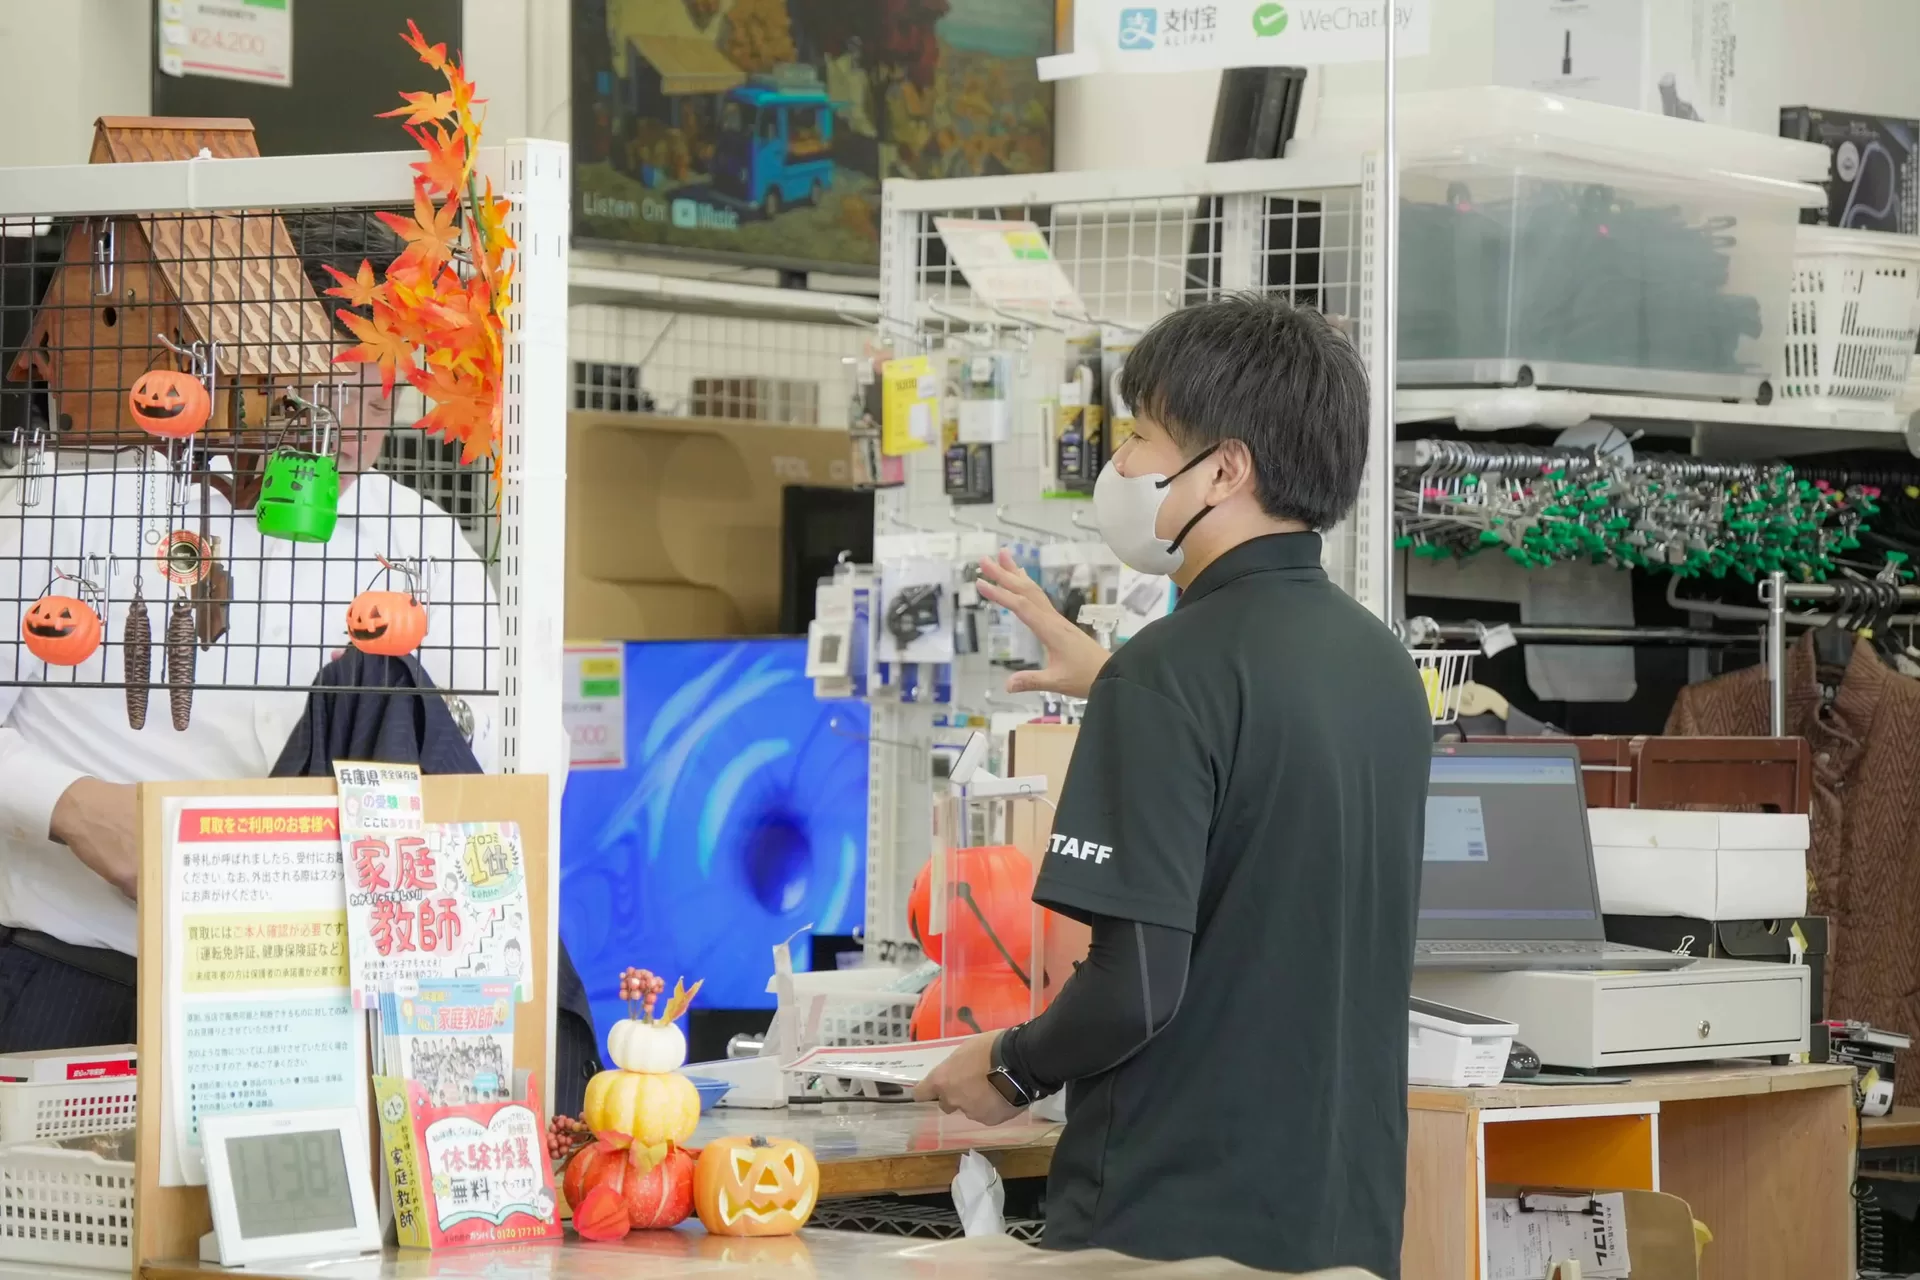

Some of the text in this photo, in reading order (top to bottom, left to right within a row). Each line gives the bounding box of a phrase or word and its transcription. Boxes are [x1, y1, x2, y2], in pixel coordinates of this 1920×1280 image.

[1163, 5, 1217, 33] 支付宝
[1299, 6, 1377, 31] WeChat
[582, 191, 636, 218] Listen
[642, 196, 666, 222] On
[340, 768, 381, 786] 兵庫県
[199, 816, 336, 834] 買取をご利用のお客様へ
[350, 835, 438, 892] 家庭
[1046, 833, 1113, 865] TAFF
[370, 898, 461, 957] 教師
[438, 1006, 494, 1031] 家庭教師
[440, 1136, 532, 1173] 体験授業
[391, 1147, 414, 1228] 家庭教師
[450, 1176, 490, 1204] 無料
